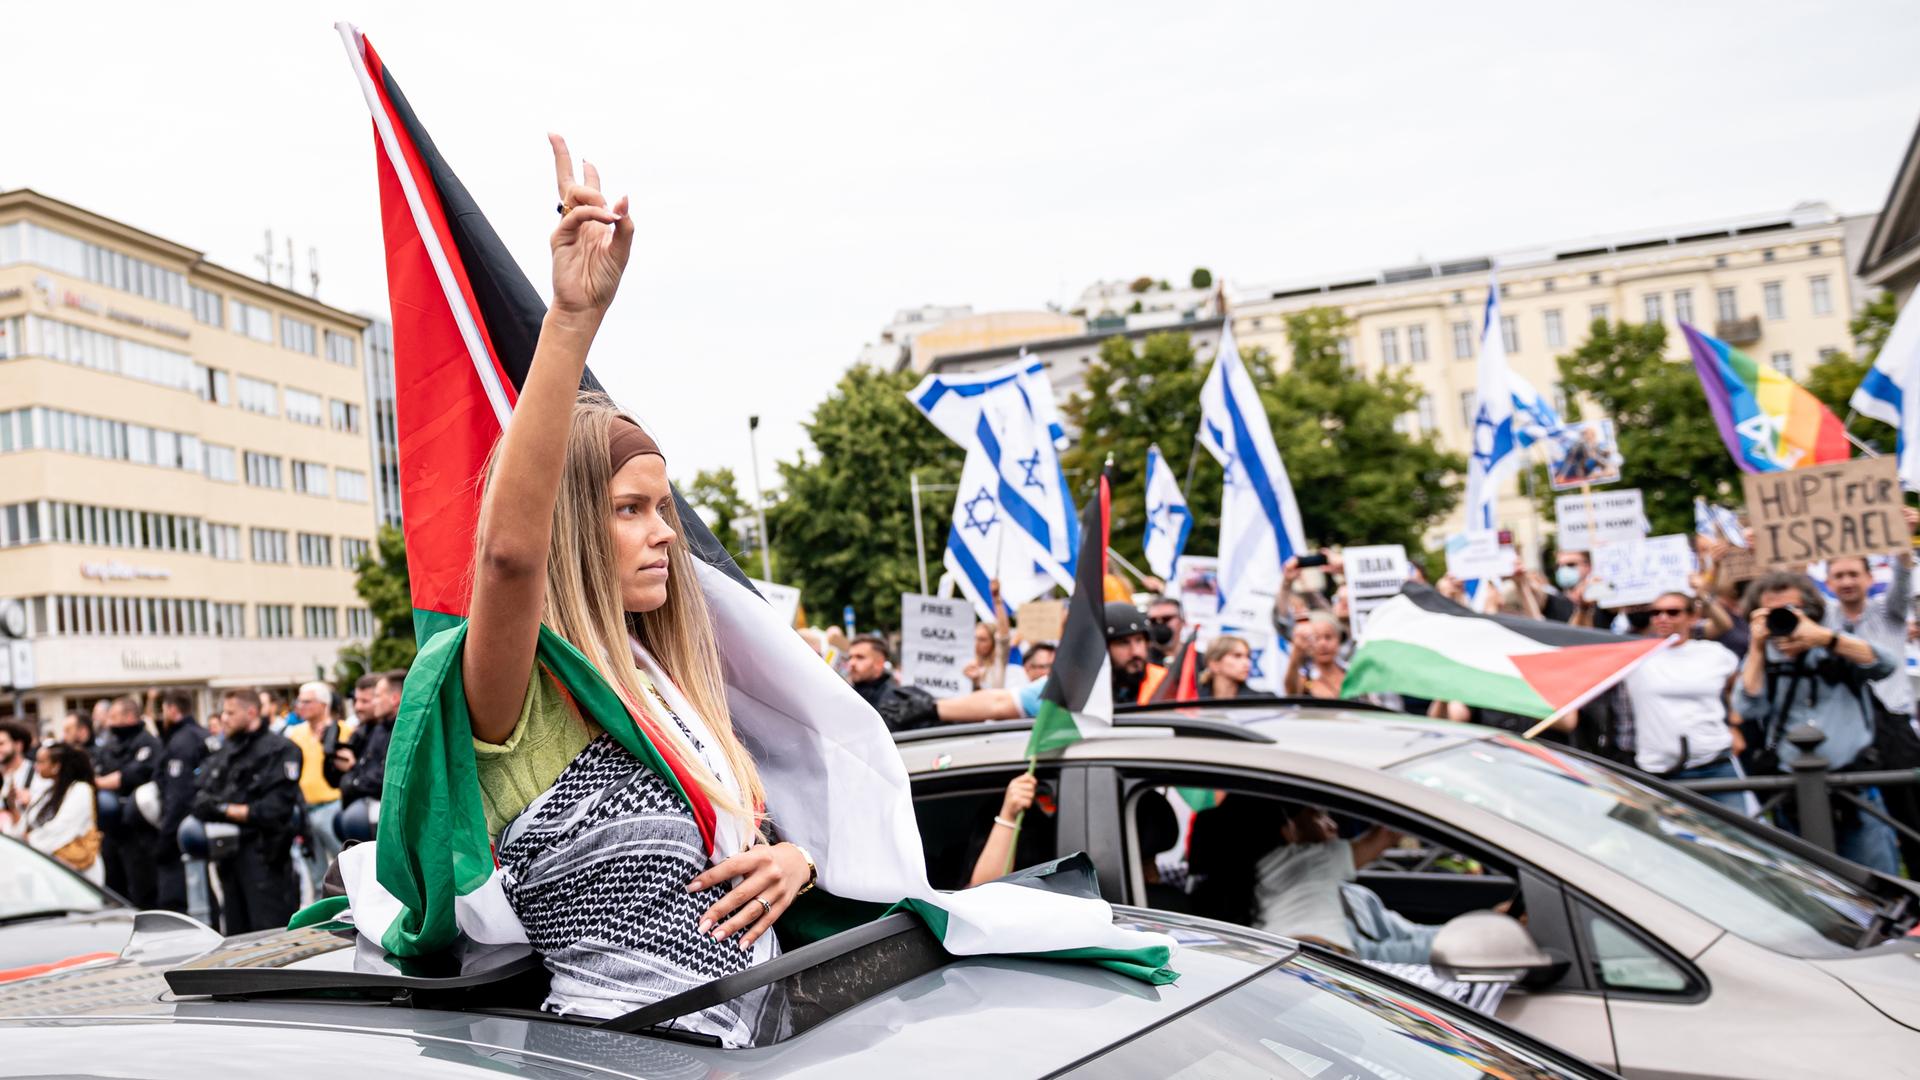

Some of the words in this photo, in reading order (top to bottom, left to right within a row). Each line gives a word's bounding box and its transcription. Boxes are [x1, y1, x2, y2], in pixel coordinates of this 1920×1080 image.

[1756, 470, 1844, 519] HUPT
[1763, 508, 1904, 563] ISRAEL
[921, 603, 953, 616] FREE
[921, 626, 957, 640] GAZA
[917, 651, 955, 664] FROM
